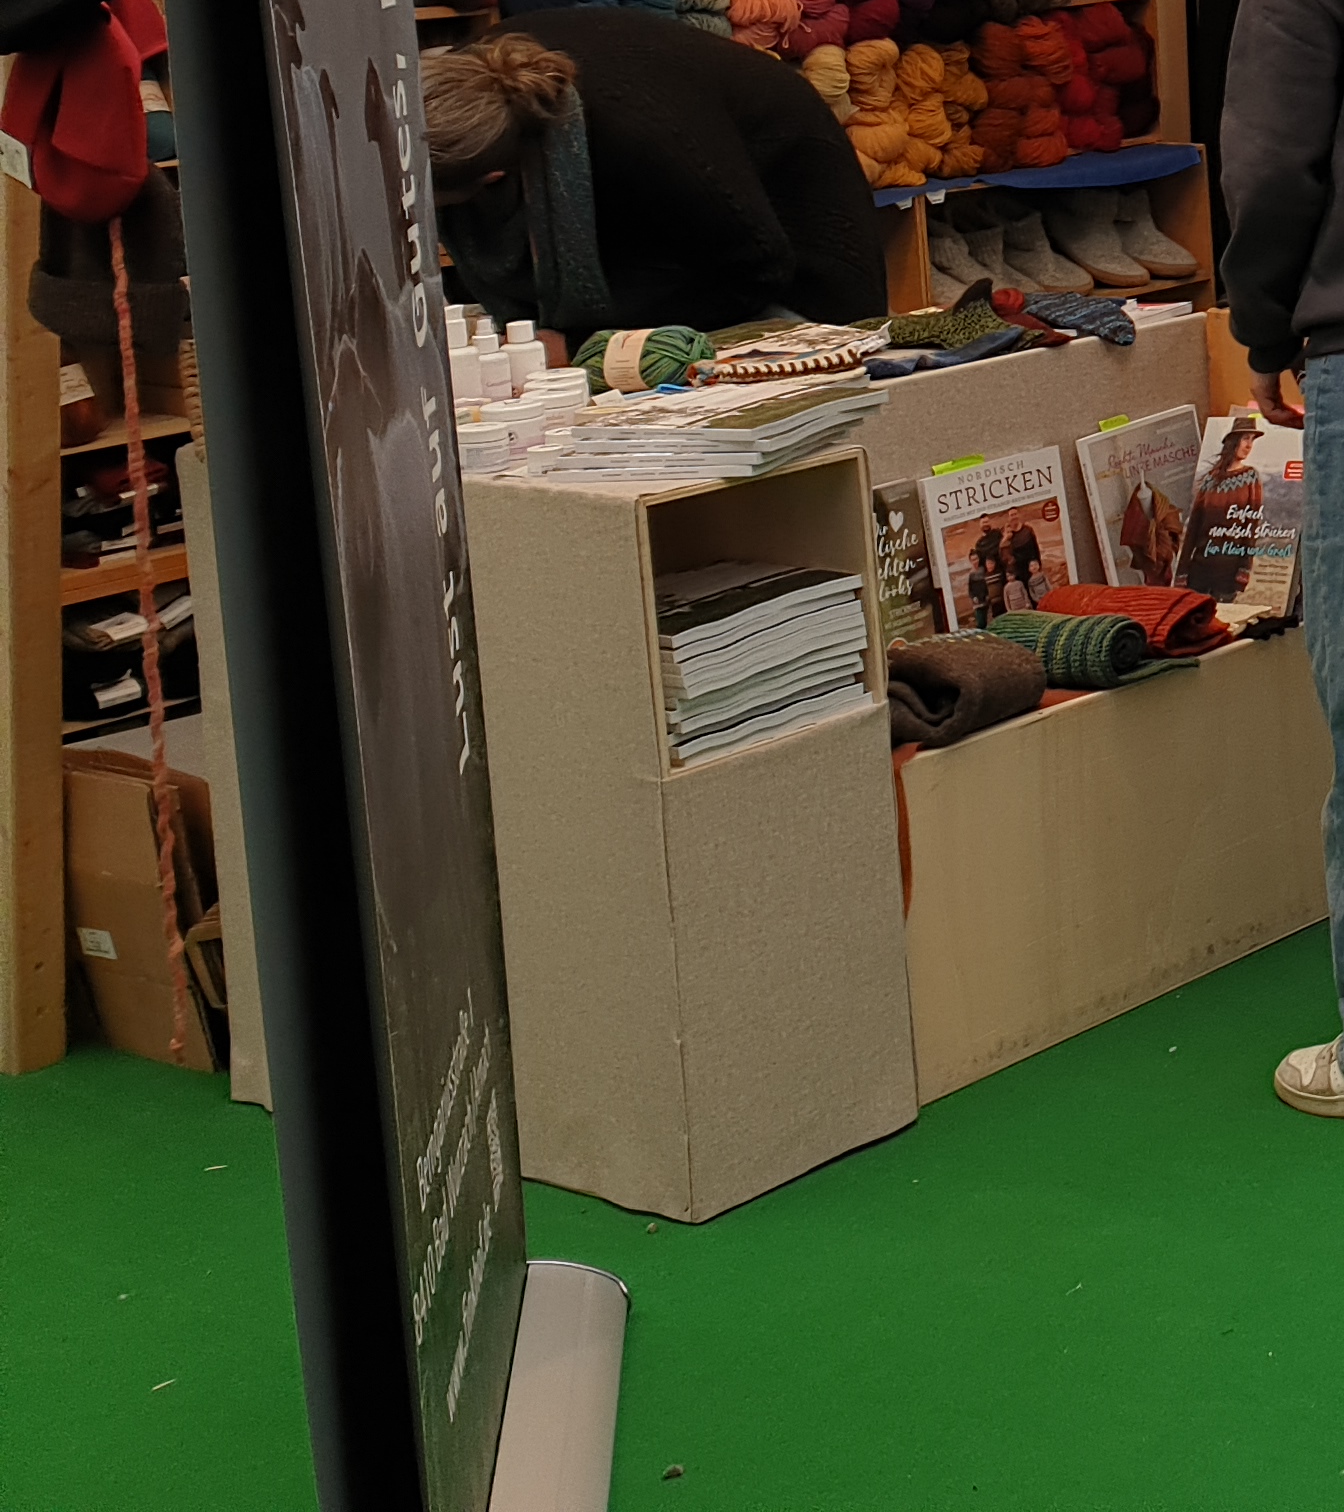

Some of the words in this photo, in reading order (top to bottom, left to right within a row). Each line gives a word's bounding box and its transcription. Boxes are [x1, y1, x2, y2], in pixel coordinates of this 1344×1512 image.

[421, 386, 449, 538] auf
[1152, 445, 1198, 469] MASCHE
[958, 461, 1024, 484] NORDISCH
[938, 466, 1053, 514] STRICKEN
[1226, 504, 1264, 524] Einfach
[1208, 523, 1252, 539] nordisch
[1254, 520, 1296, 539] stricken
[1204, 540, 1220, 558] für
[1221, 543, 1246, 557] Klein
[442, 570, 472, 777] Lust
